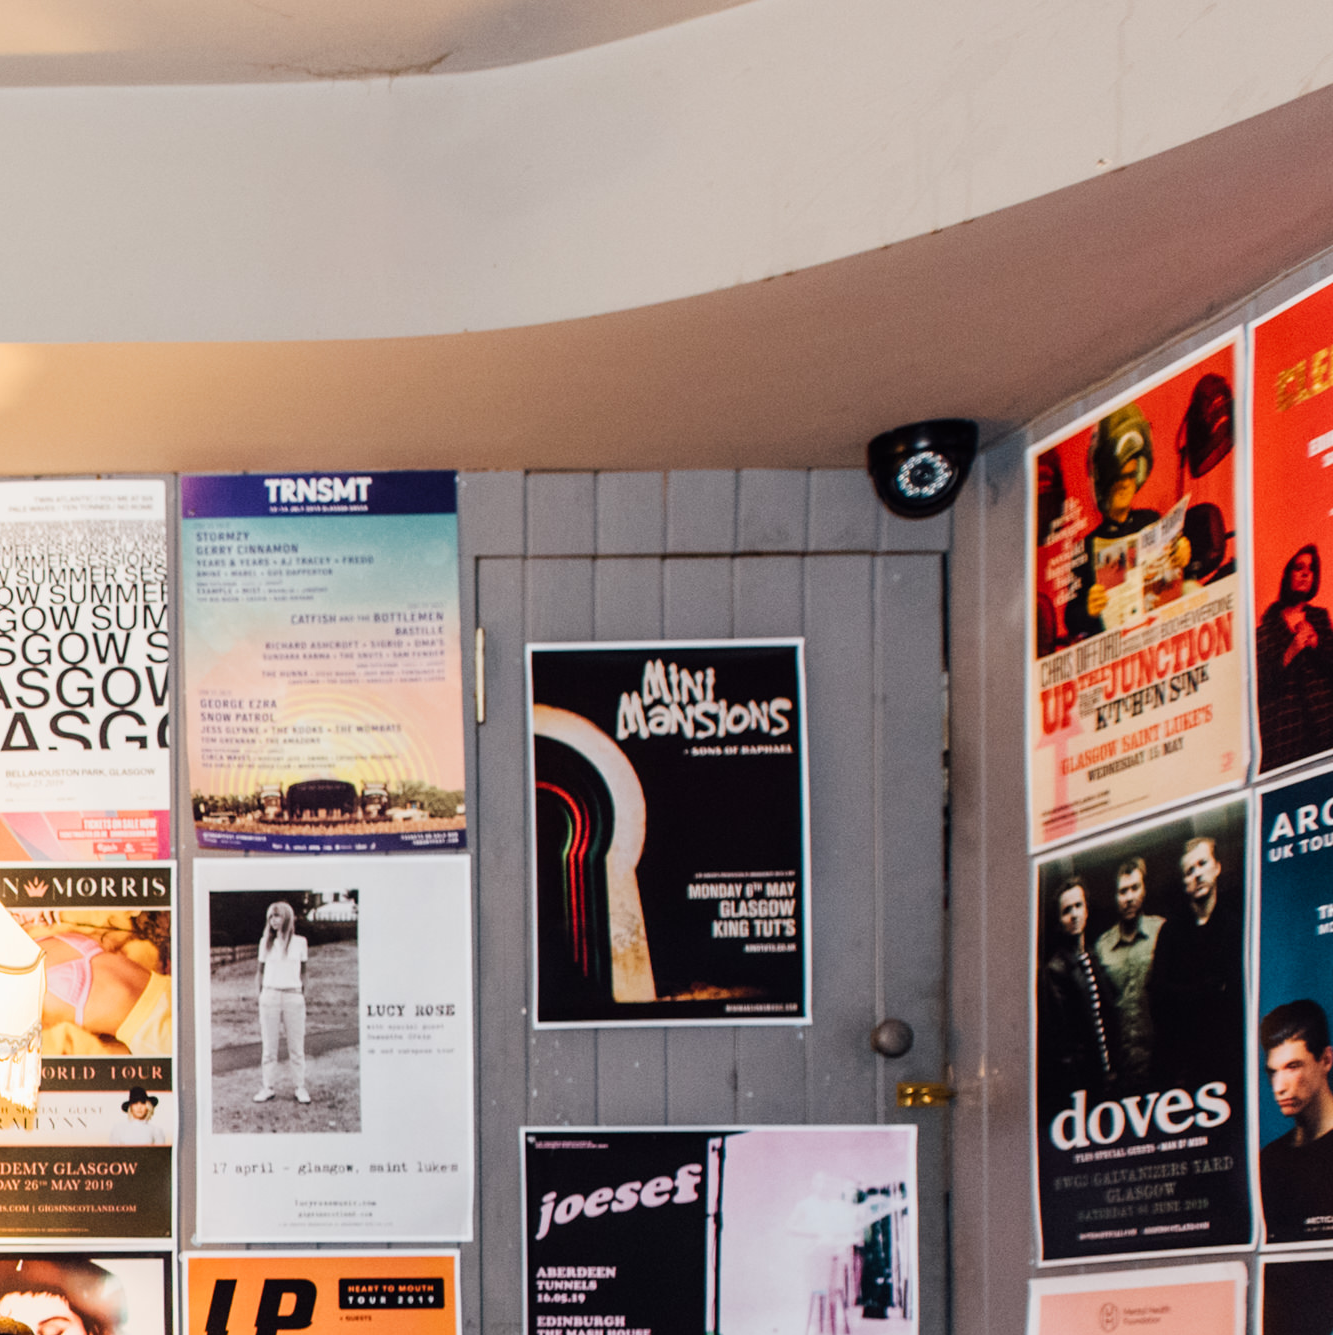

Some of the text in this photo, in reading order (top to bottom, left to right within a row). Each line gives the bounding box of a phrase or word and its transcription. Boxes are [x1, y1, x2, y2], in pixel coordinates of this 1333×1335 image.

[264, 476, 373, 503] TRNSMT
[196, 532, 250, 542] STORMZY
[196, 544, 299, 555] GERRY CINNAMON
[291, 612, 444, 625] CATFISH BOTTLEMEN
[395, 627, 444, 635] BASTILLE
[145, 631, 169, 664] S
[1041, 631, 1121, 688] CHRIS DIFFORD
[1040, 611, 1234, 735] UP THE JUNCTION
[200, 699, 277, 709] GEORGE EZRA
[1095, 663, 1210, 732] KITCHEN SINK
[201, 713, 275, 722] SNOW PATROL
[5, 767, 156, 778] BELLAHOUSTON PARK, GLASGOW
[1268, 833, 1333, 862] UK TOU
[53, 876, 167, 899] MORRIS
[719, 899, 796, 918] GLASGOW
[712, 919, 797, 938] KING TUT'S
[366, 1004, 456, 1018] LUCY ROSE
[1050, 1081, 1231, 1151] doves
[53, 1161, 138, 1175] GLASGOW
[212, 1163, 227, 1173] 17
[235, 1163, 273, 1176] april
[297, 1163, 360, 1176] glasgow,
[370, 1162, 408, 1173] saint
[38, 1203, 137, 1213] GIGSINSCOTLAND.COM
[535, 1163, 703, 1241] joesef
[536, 1266, 617, 1279] ABERDEEN
[536, 1279, 598, 1291] TUNNELS
[348, 1295, 435, 1305] TOUR 2019
[537, 1315, 626, 1327] EDINBURGH
